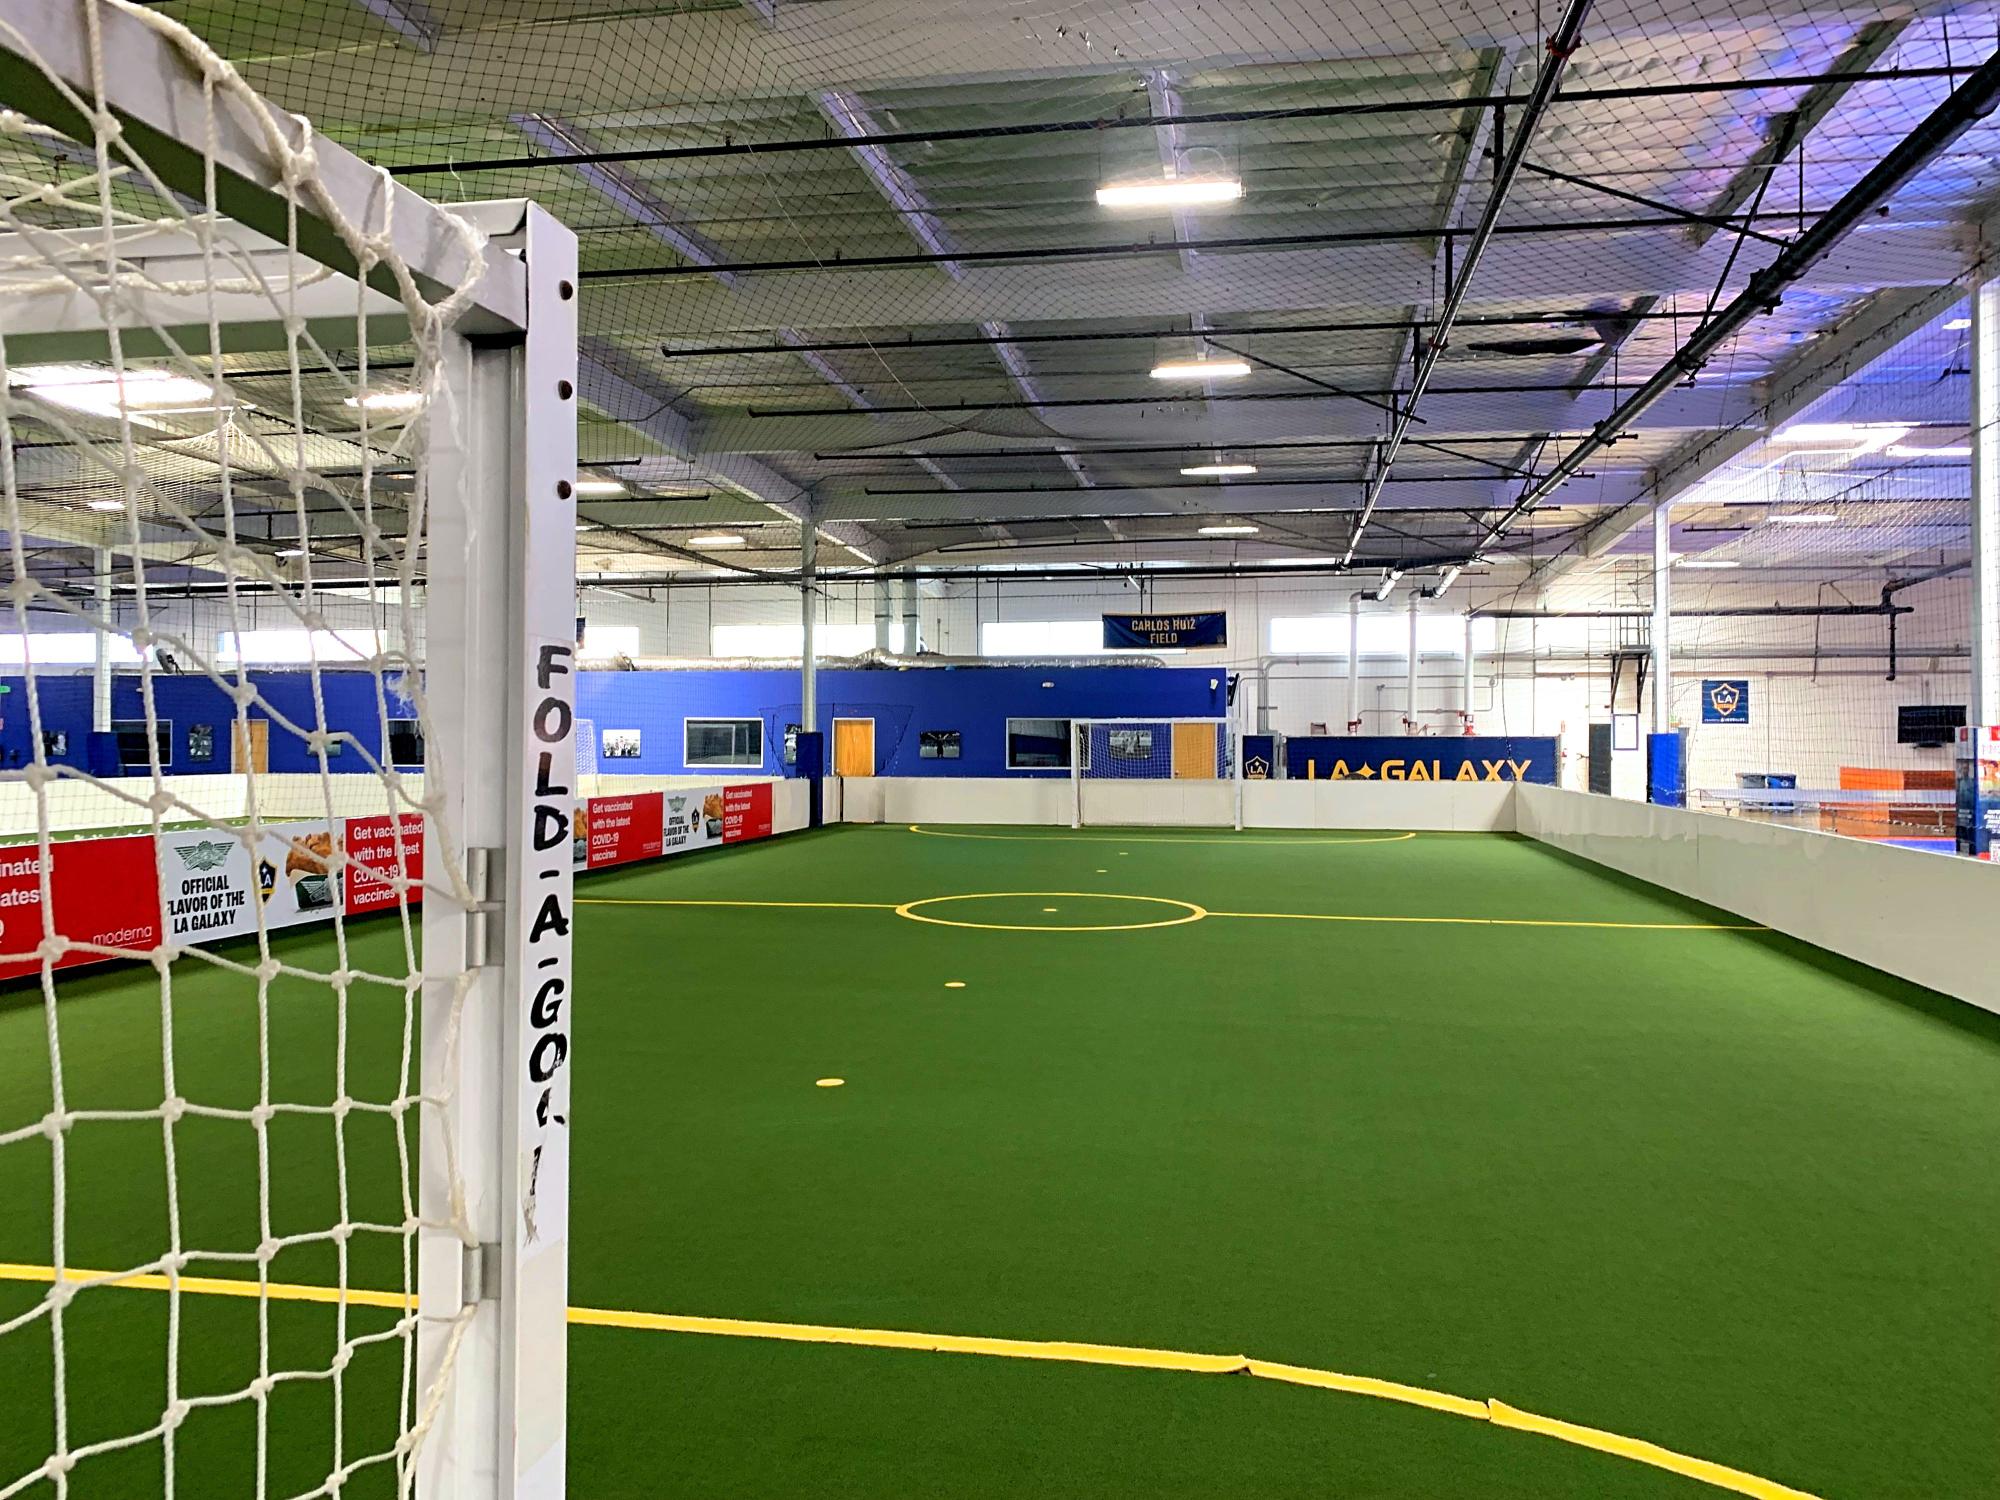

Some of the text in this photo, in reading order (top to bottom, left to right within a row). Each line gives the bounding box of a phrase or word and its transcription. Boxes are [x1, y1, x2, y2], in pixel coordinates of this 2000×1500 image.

[1131, 618, 1197, 632] CARLOS RUIZ
[1150, 632, 1178, 644] FIELD
[1717, 694, 1733, 704] LA
[1250, 765, 1264, 774] LA
[1380, 759, 1532, 781] GALAXY
[353, 821, 423, 840] Get vaccnated
[353, 841, 420, 862] with the lest
[181, 875, 230, 896] OFFICIAL
[210, 893, 224, 910] OF
[226, 890, 245, 907] THE
[353, 888, 396, 905] vaccines
[174, 909, 237, 934] LA GALAXY
[92, 925, 153, 945] moderna
